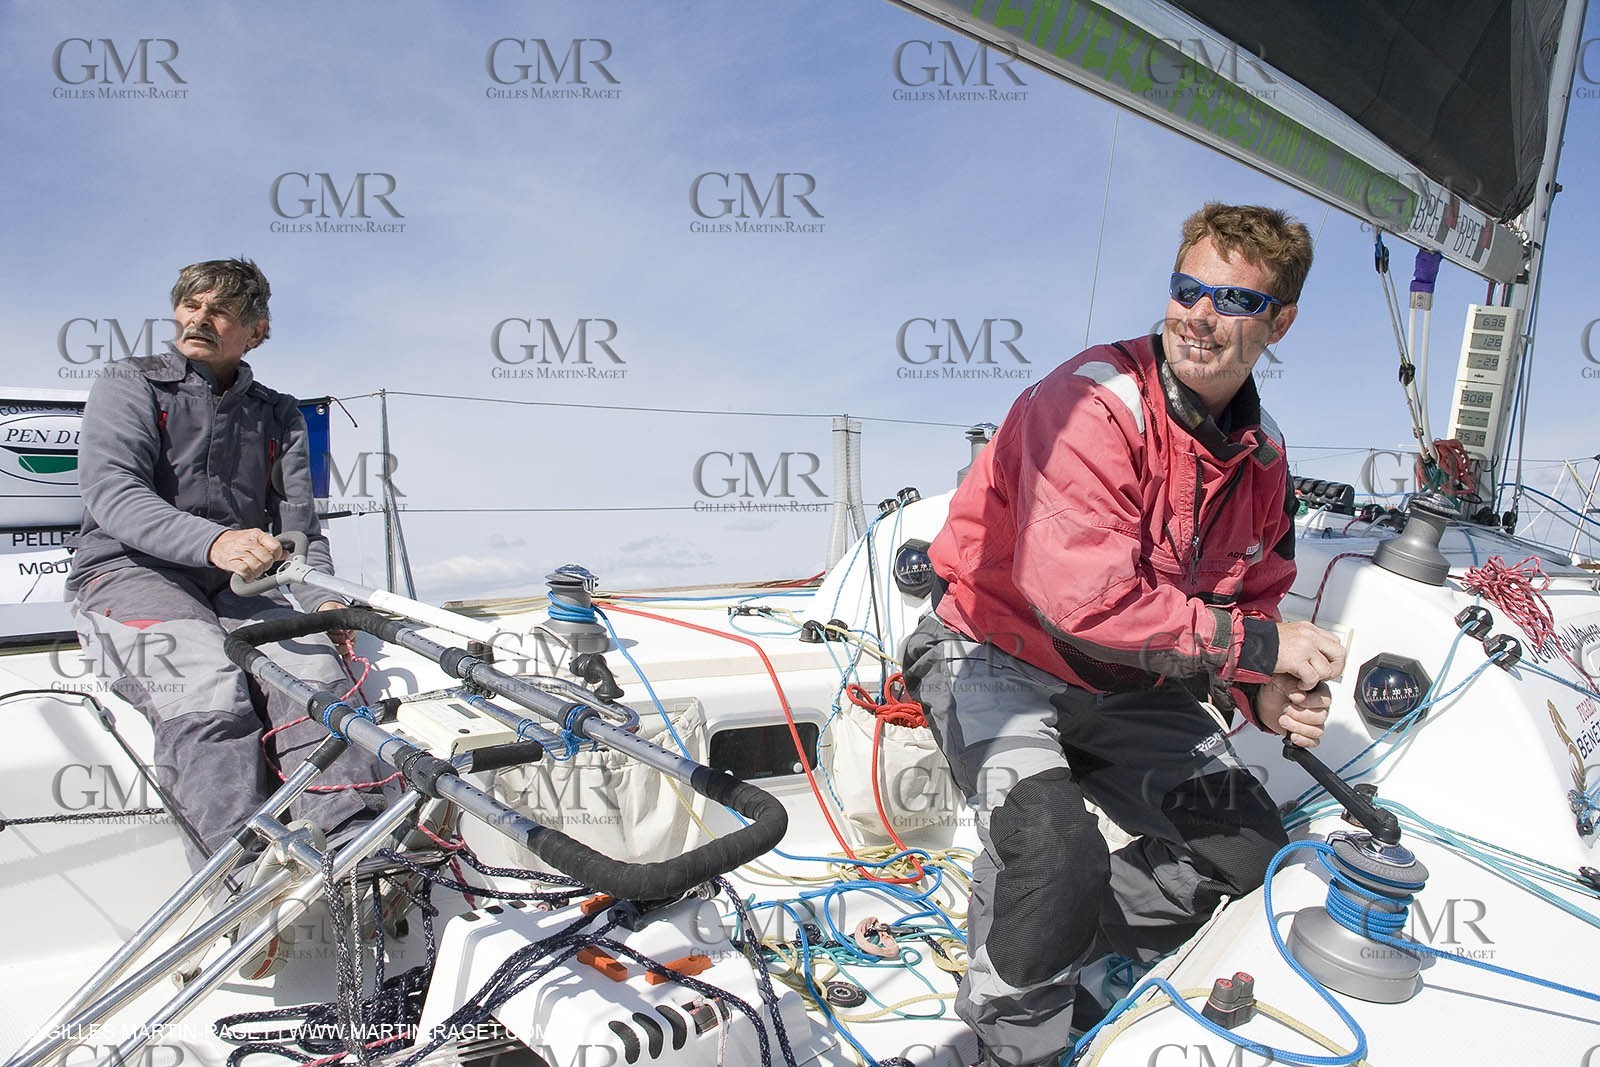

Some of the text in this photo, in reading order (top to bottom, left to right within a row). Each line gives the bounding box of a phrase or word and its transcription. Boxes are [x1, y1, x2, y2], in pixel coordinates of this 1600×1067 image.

[5, 428, 50, 443] PEN
[12, 531, 81, 547] PELL
[18, 561, 72, 576] MOU
[1576, 719, 1600, 760] BÉNÉ
